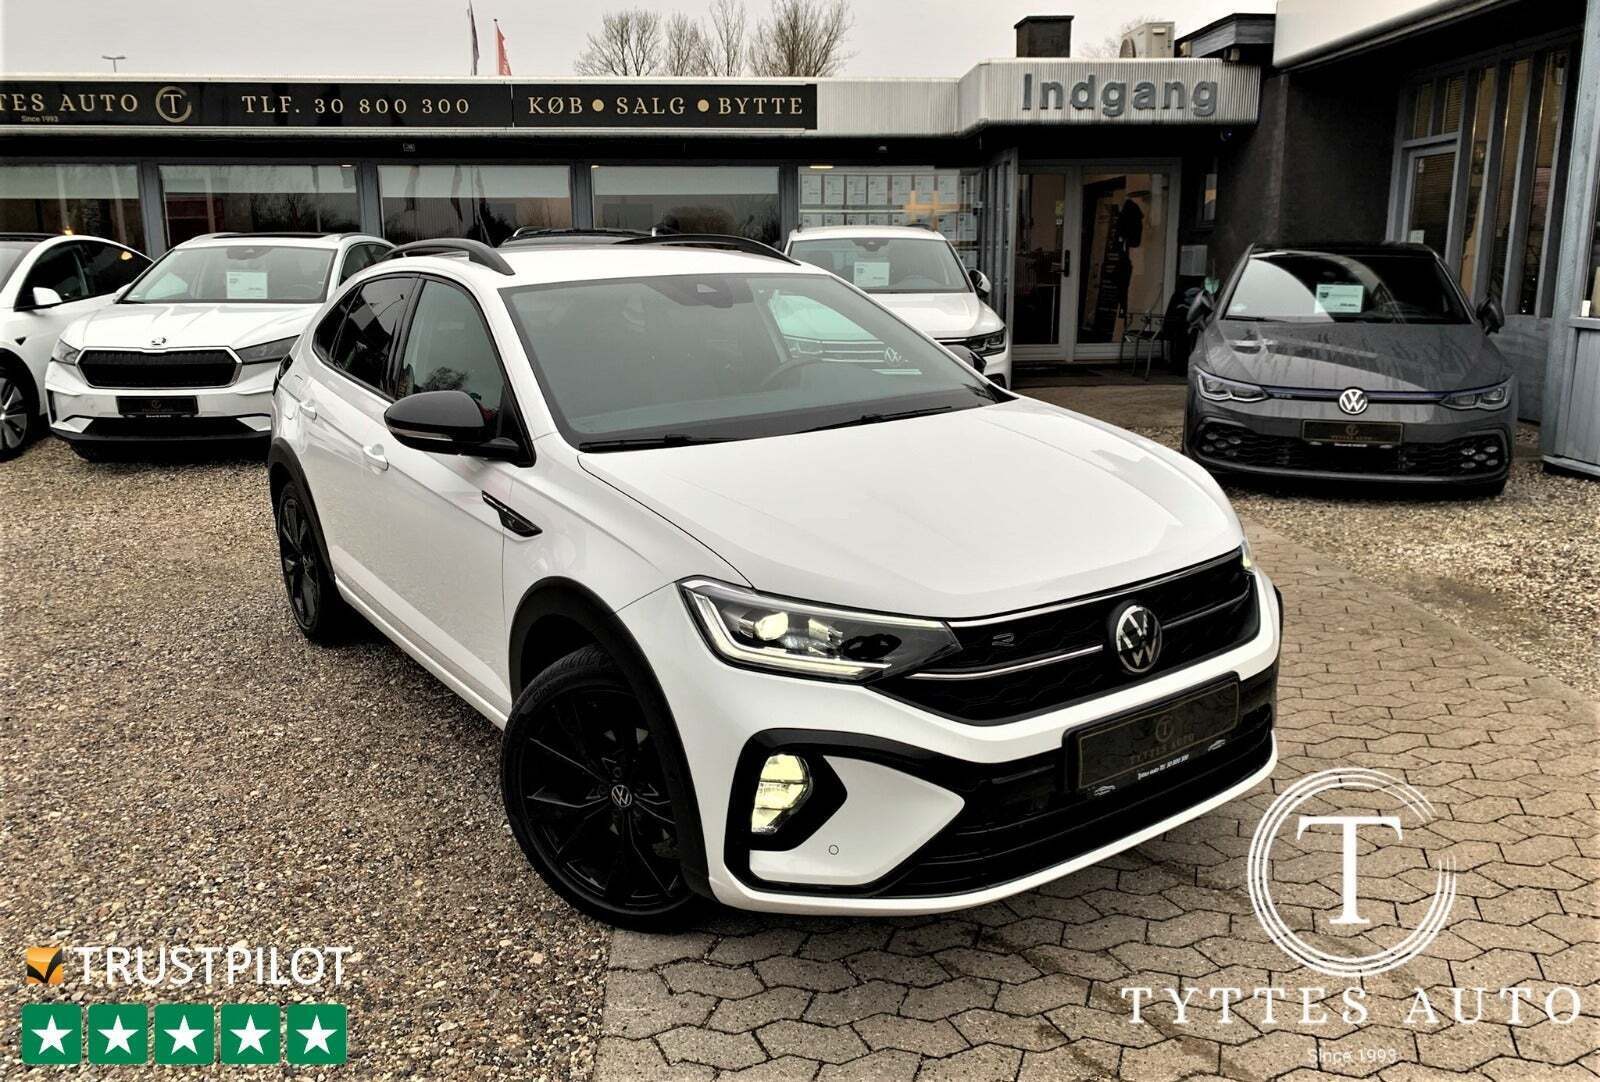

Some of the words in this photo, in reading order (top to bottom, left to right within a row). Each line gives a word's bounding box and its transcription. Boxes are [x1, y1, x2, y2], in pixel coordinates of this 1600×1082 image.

[59, 94, 138, 113] AUTO
[1022, 73, 1218, 117] Indgang
[241, 95, 300, 114] TLF.
[314, 98, 345, 115] 30
[359, 98, 408, 115] 800
[422, 98, 470, 115] 300
[528, 96, 584, 115] KØB
[616, 97, 686, 115] SALG
[718, 97, 803, 115] BYTTE
